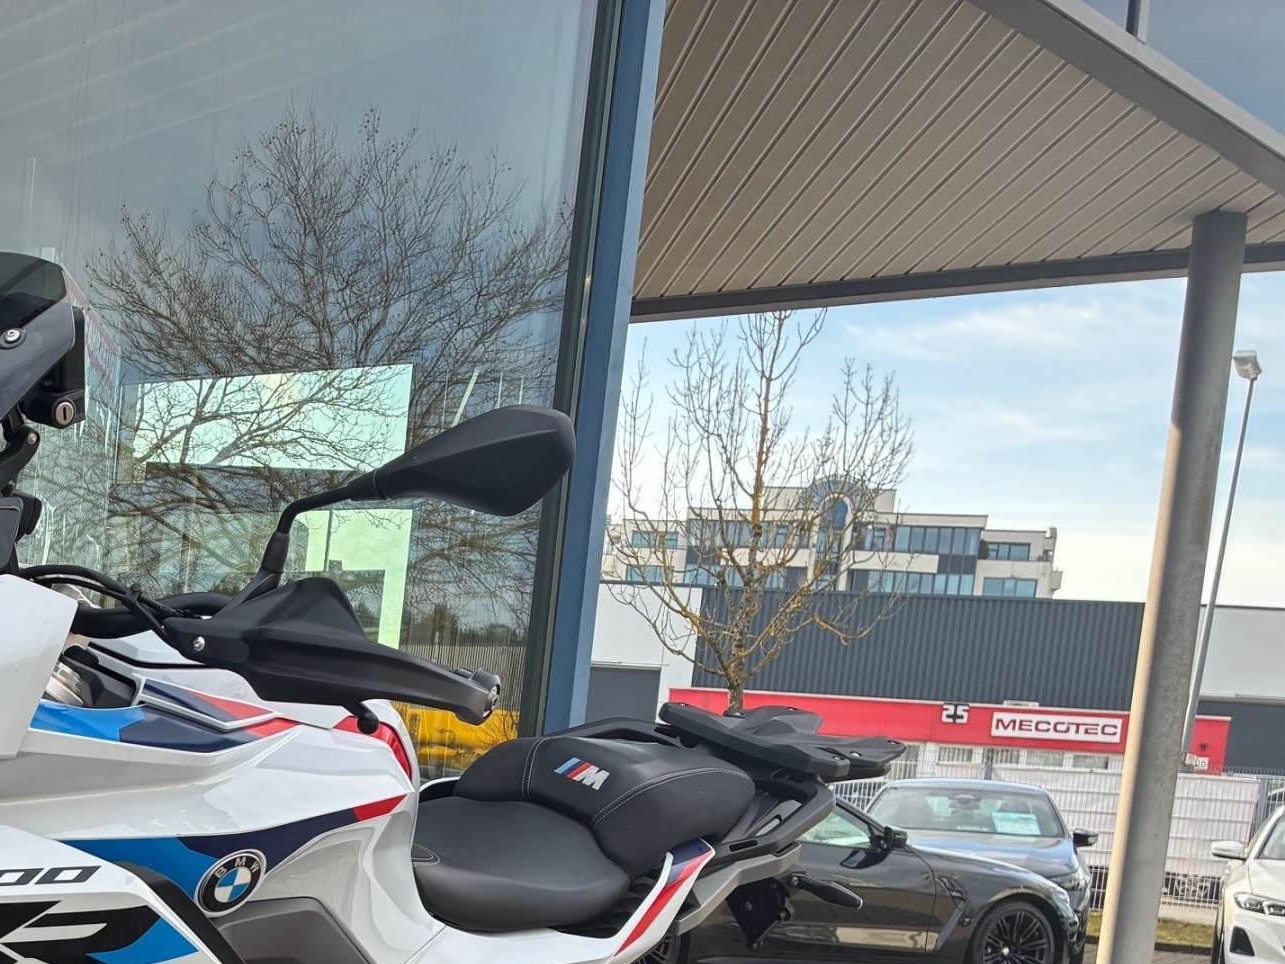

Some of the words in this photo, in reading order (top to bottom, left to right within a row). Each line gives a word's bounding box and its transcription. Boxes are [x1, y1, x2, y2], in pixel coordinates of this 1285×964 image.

[941, 704, 970, 724] 25
[994, 718, 1118, 736] MECOTEC
[214, 856, 261, 879] BMW
